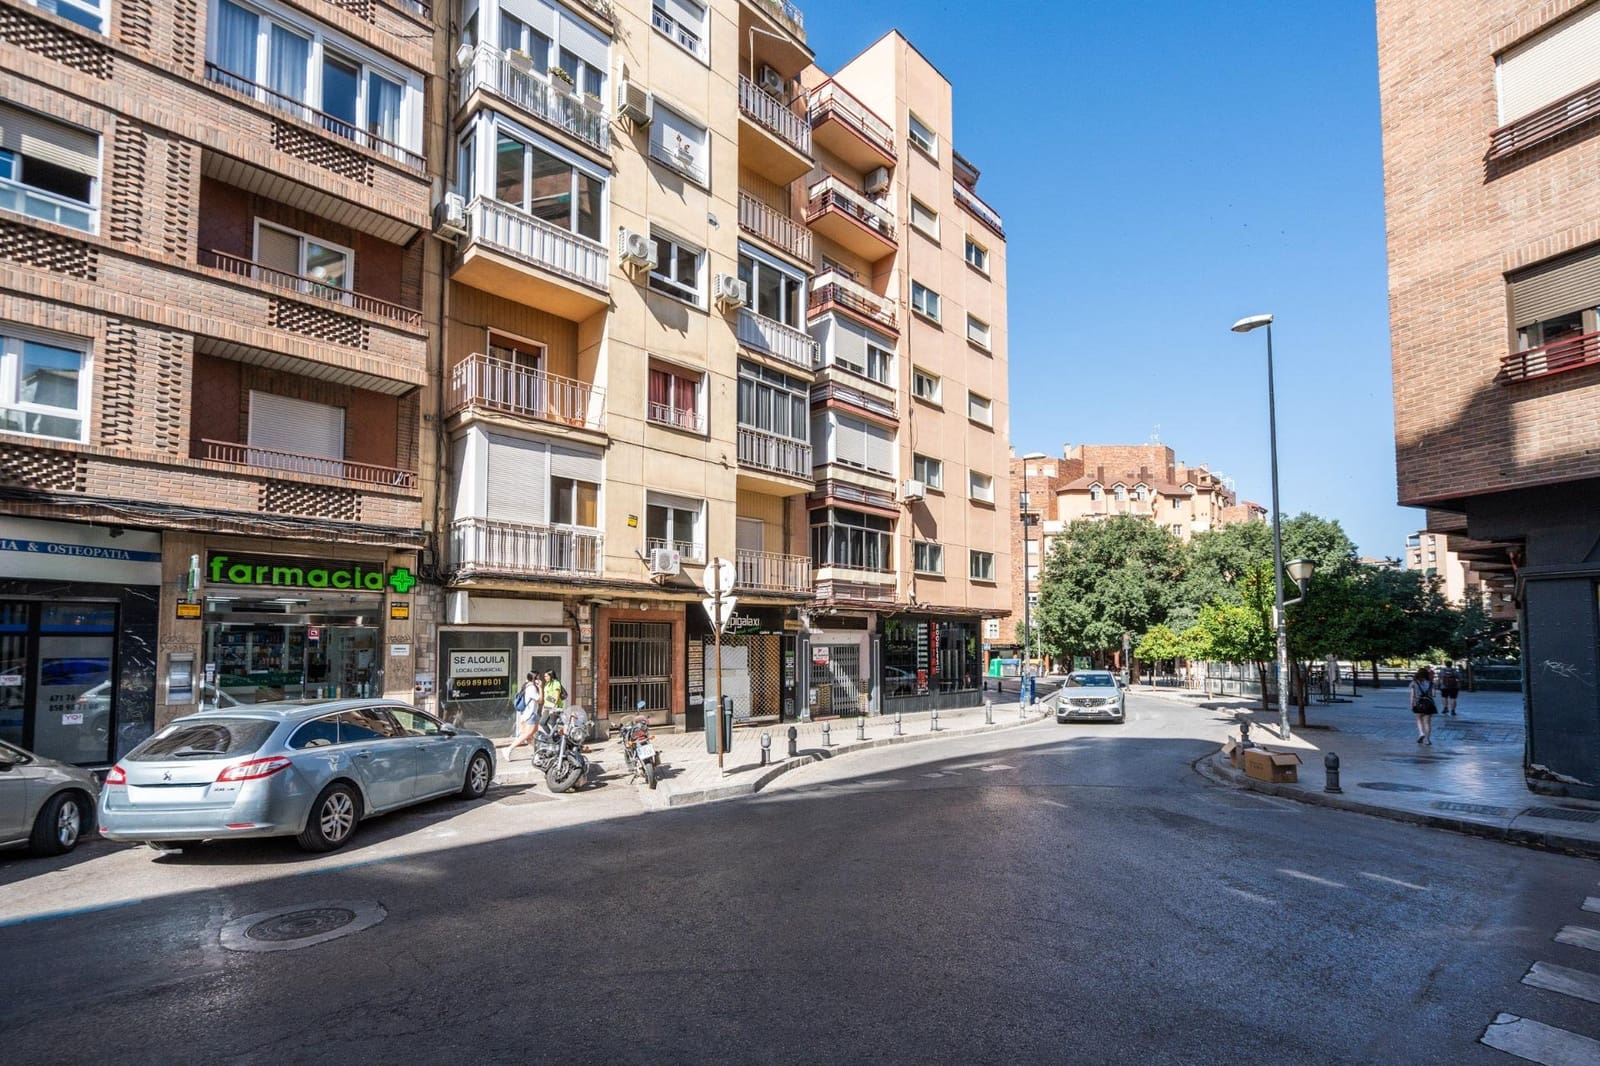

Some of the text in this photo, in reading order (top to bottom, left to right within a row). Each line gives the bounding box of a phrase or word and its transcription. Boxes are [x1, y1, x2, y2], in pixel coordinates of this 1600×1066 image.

[0, 540, 129, 560] IA & OSTEOPATIA
[210, 556, 383, 590] farmacia
[468, 655, 505, 664] ALQUILA
